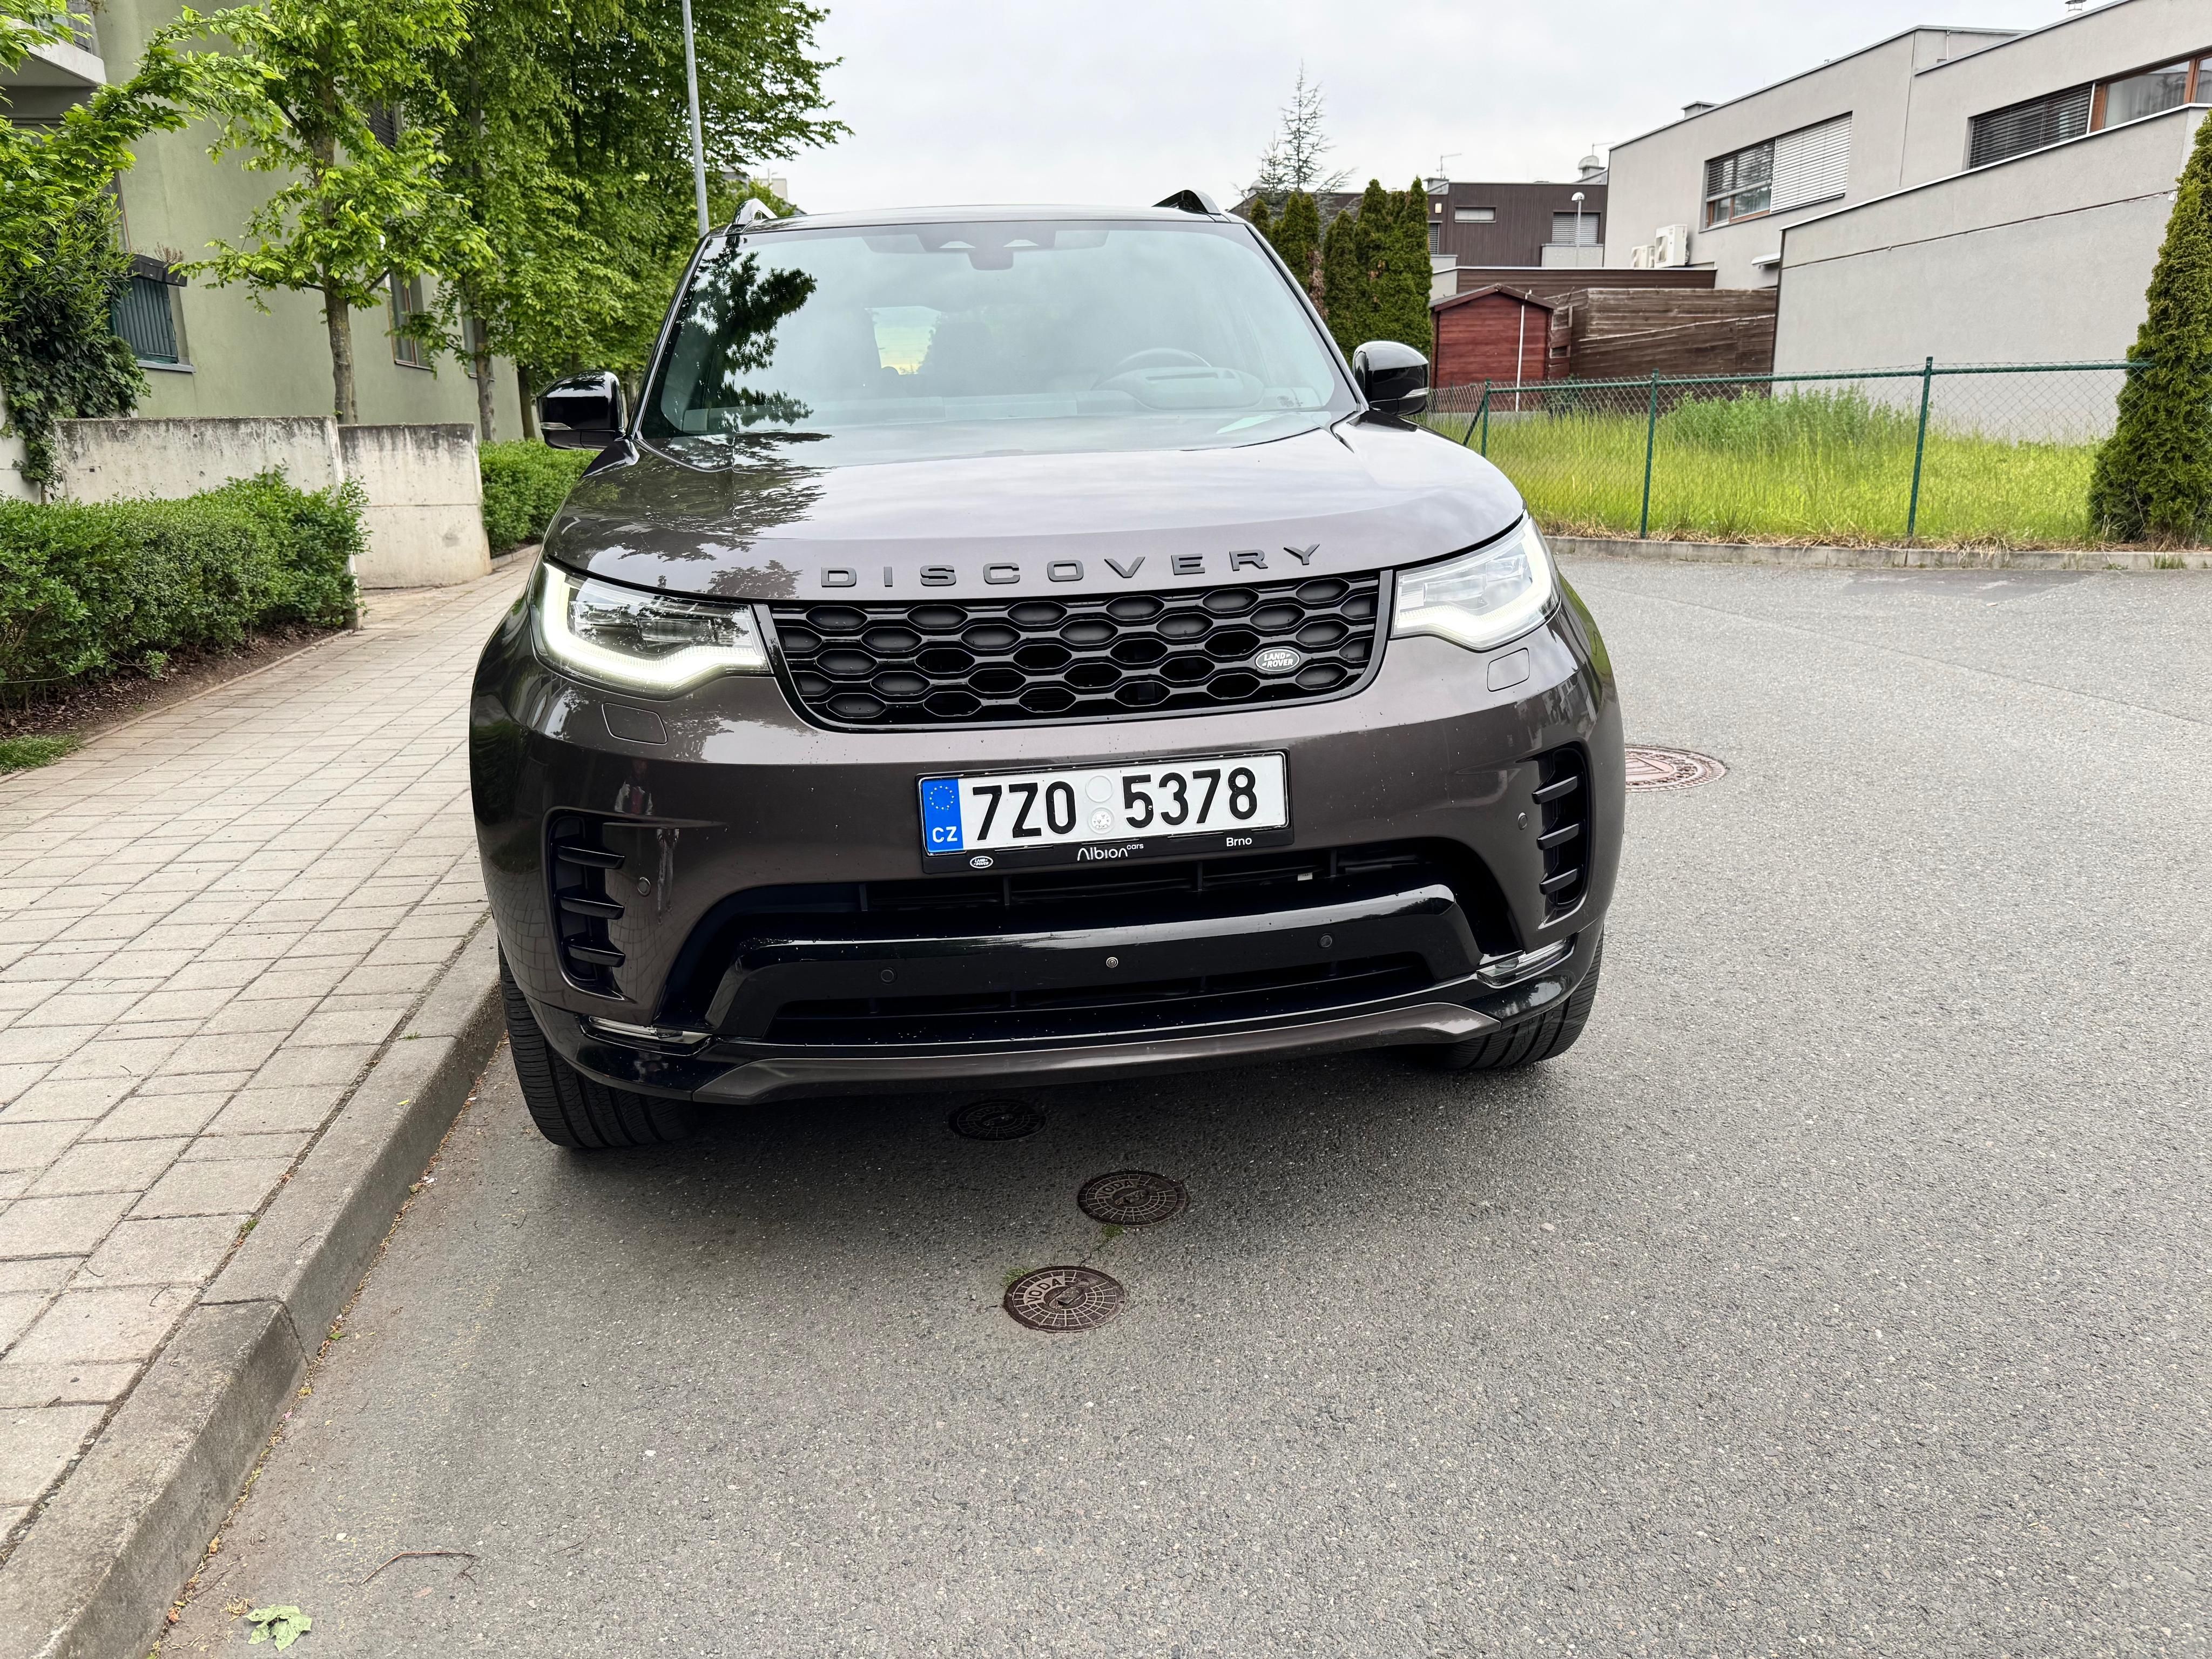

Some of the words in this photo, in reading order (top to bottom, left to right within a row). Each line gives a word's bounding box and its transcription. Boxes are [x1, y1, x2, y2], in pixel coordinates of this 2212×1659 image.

[821, 543, 1320, 588] DISCOVERY
[1264, 652, 1286, 662] LAND
[1267, 658, 1293, 668] ROVER
[972, 781, 1077, 841] 7Z0
[1122, 767, 1257, 828] 5378
[932, 826, 958, 843] CZ
[1226, 837, 1252, 847] Brno
[1077, 846, 1128, 861] Albion
[1096, 1180, 1133, 1198] VODA
[1027, 1278, 1063, 1304] VODA
